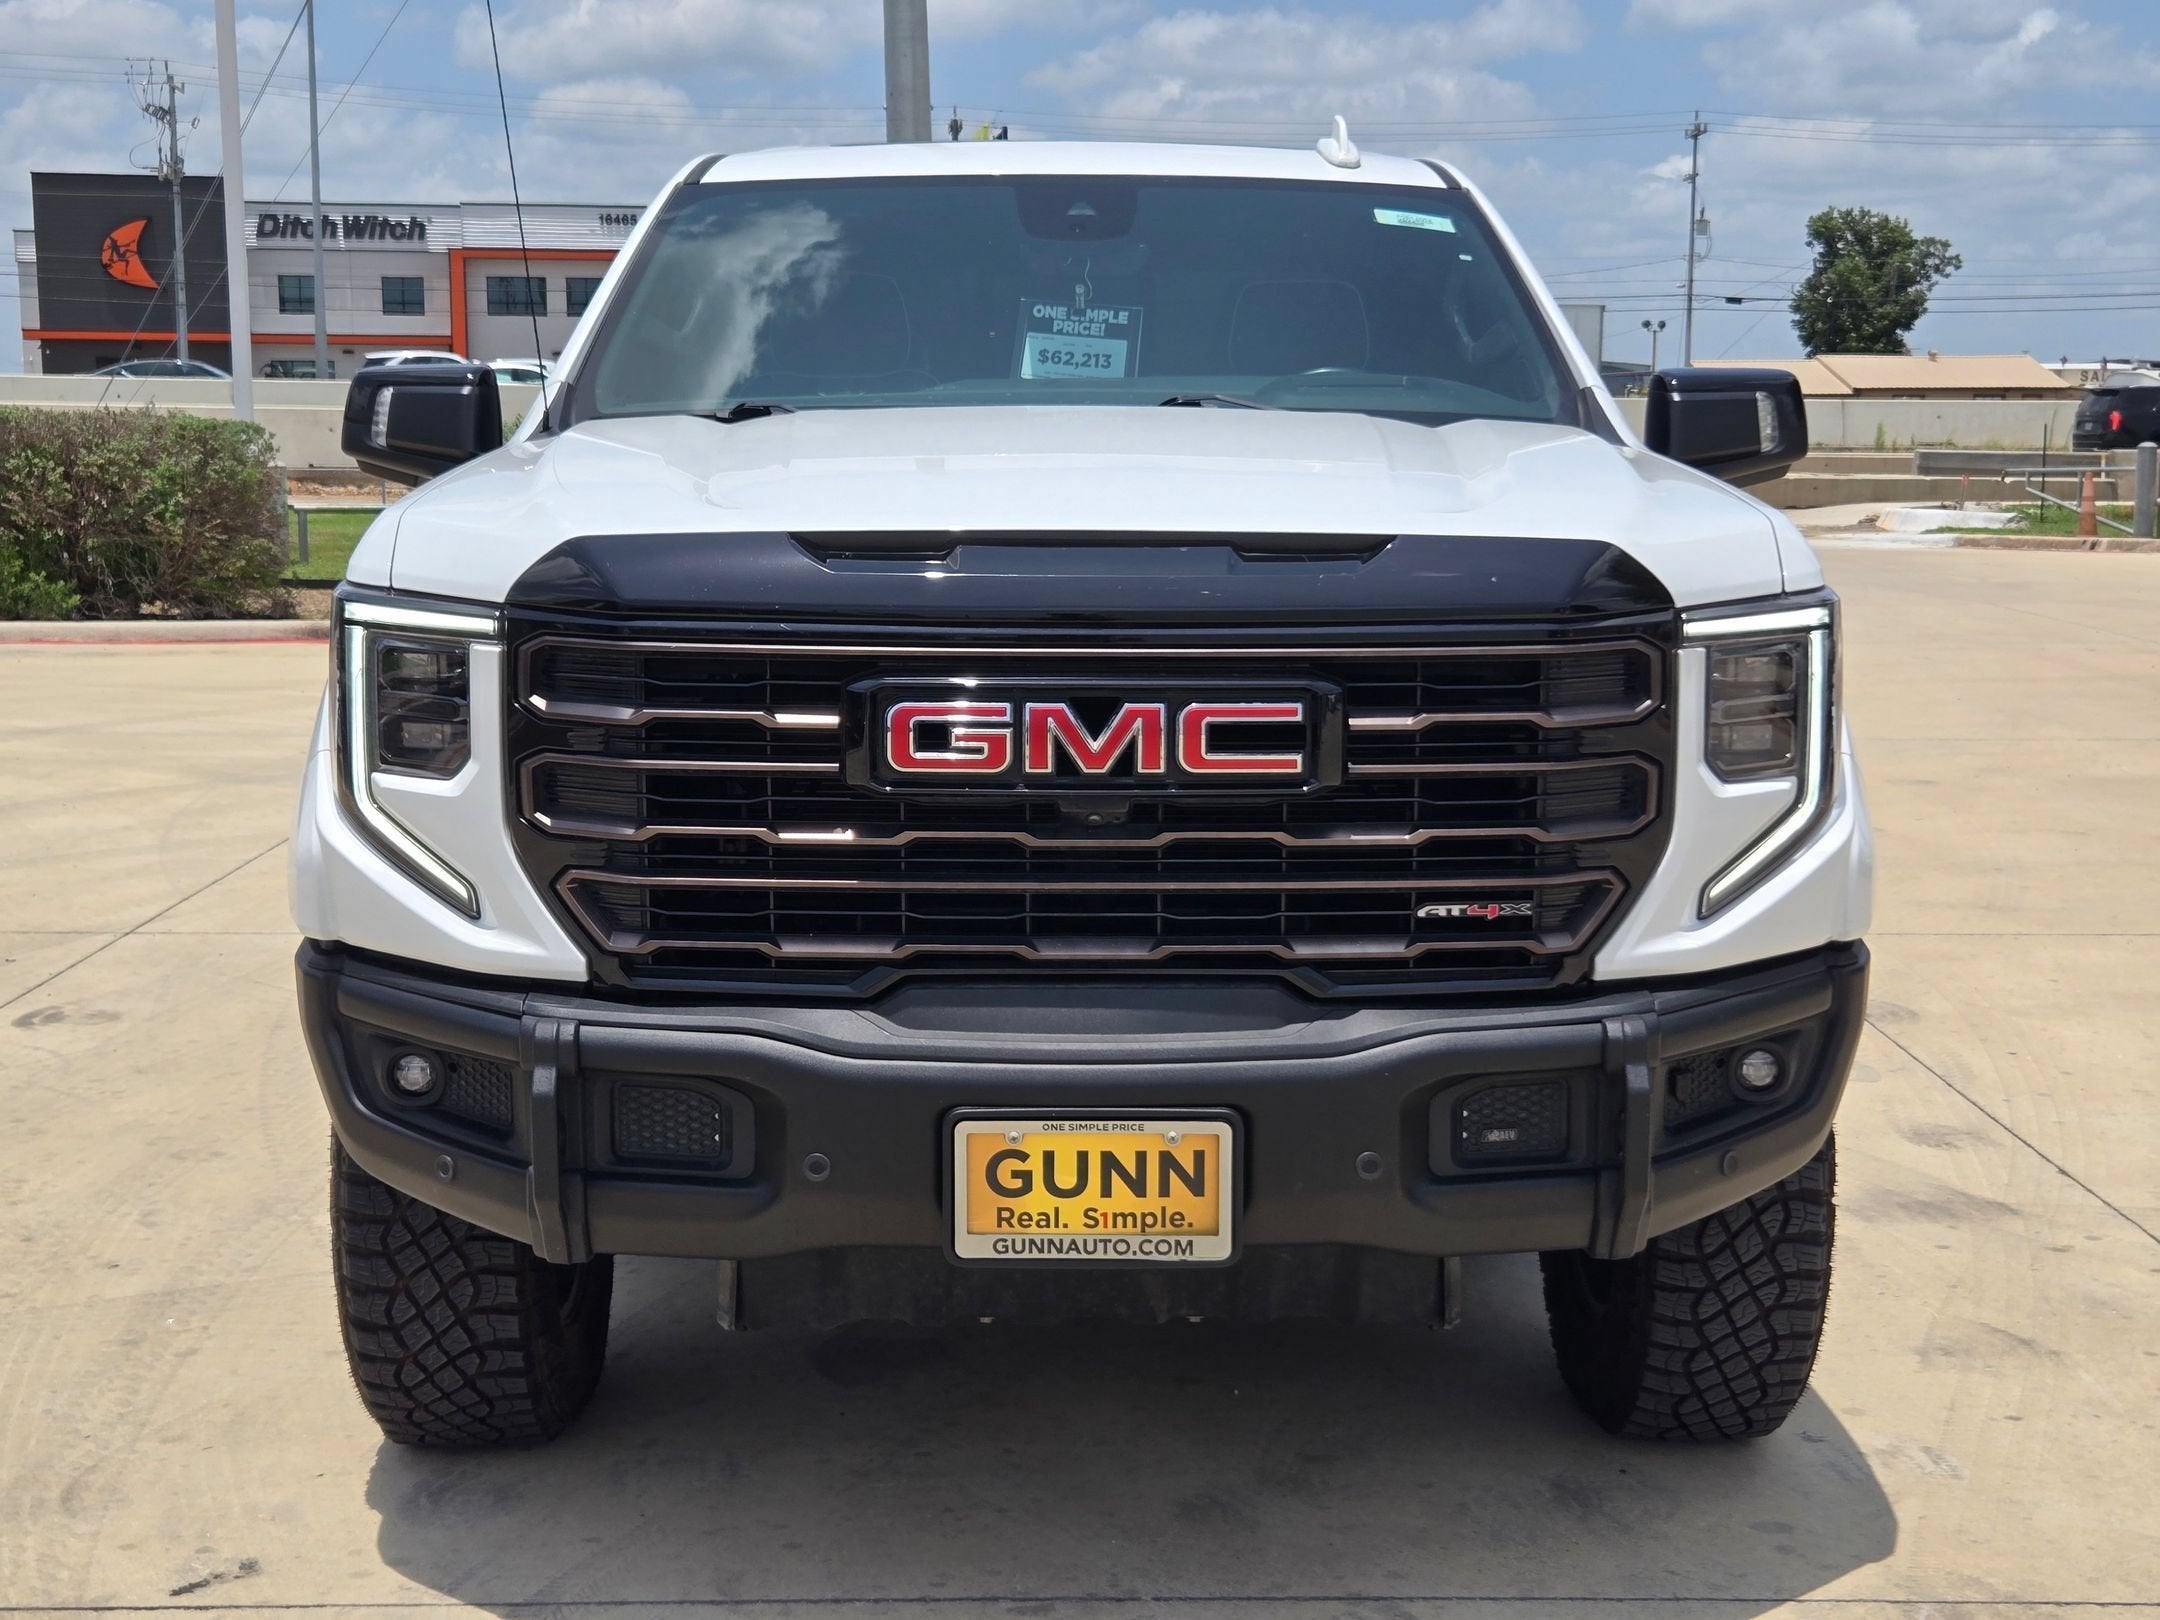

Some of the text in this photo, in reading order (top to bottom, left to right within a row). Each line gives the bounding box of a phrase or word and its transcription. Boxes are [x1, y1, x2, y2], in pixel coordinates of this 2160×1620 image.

[256, 213, 427, 241] Ditch Witch
[1032, 304, 1129, 325] ONE MPLE
[1052, 319, 1106, 337] PRICE!
[1037, 348, 1113, 370] $62,213
[886, 702, 1303, 774] GMC
[1416, 903, 1533, 920] AT4X
[1042, 1123, 1145, 1132] ONE SIMPLE PRICE
[985, 1148, 1206, 1199] GUNN
[995, 1206, 1069, 1229] Real.
[992, 1238, 1195, 1257] GUNNAUTO.COM
